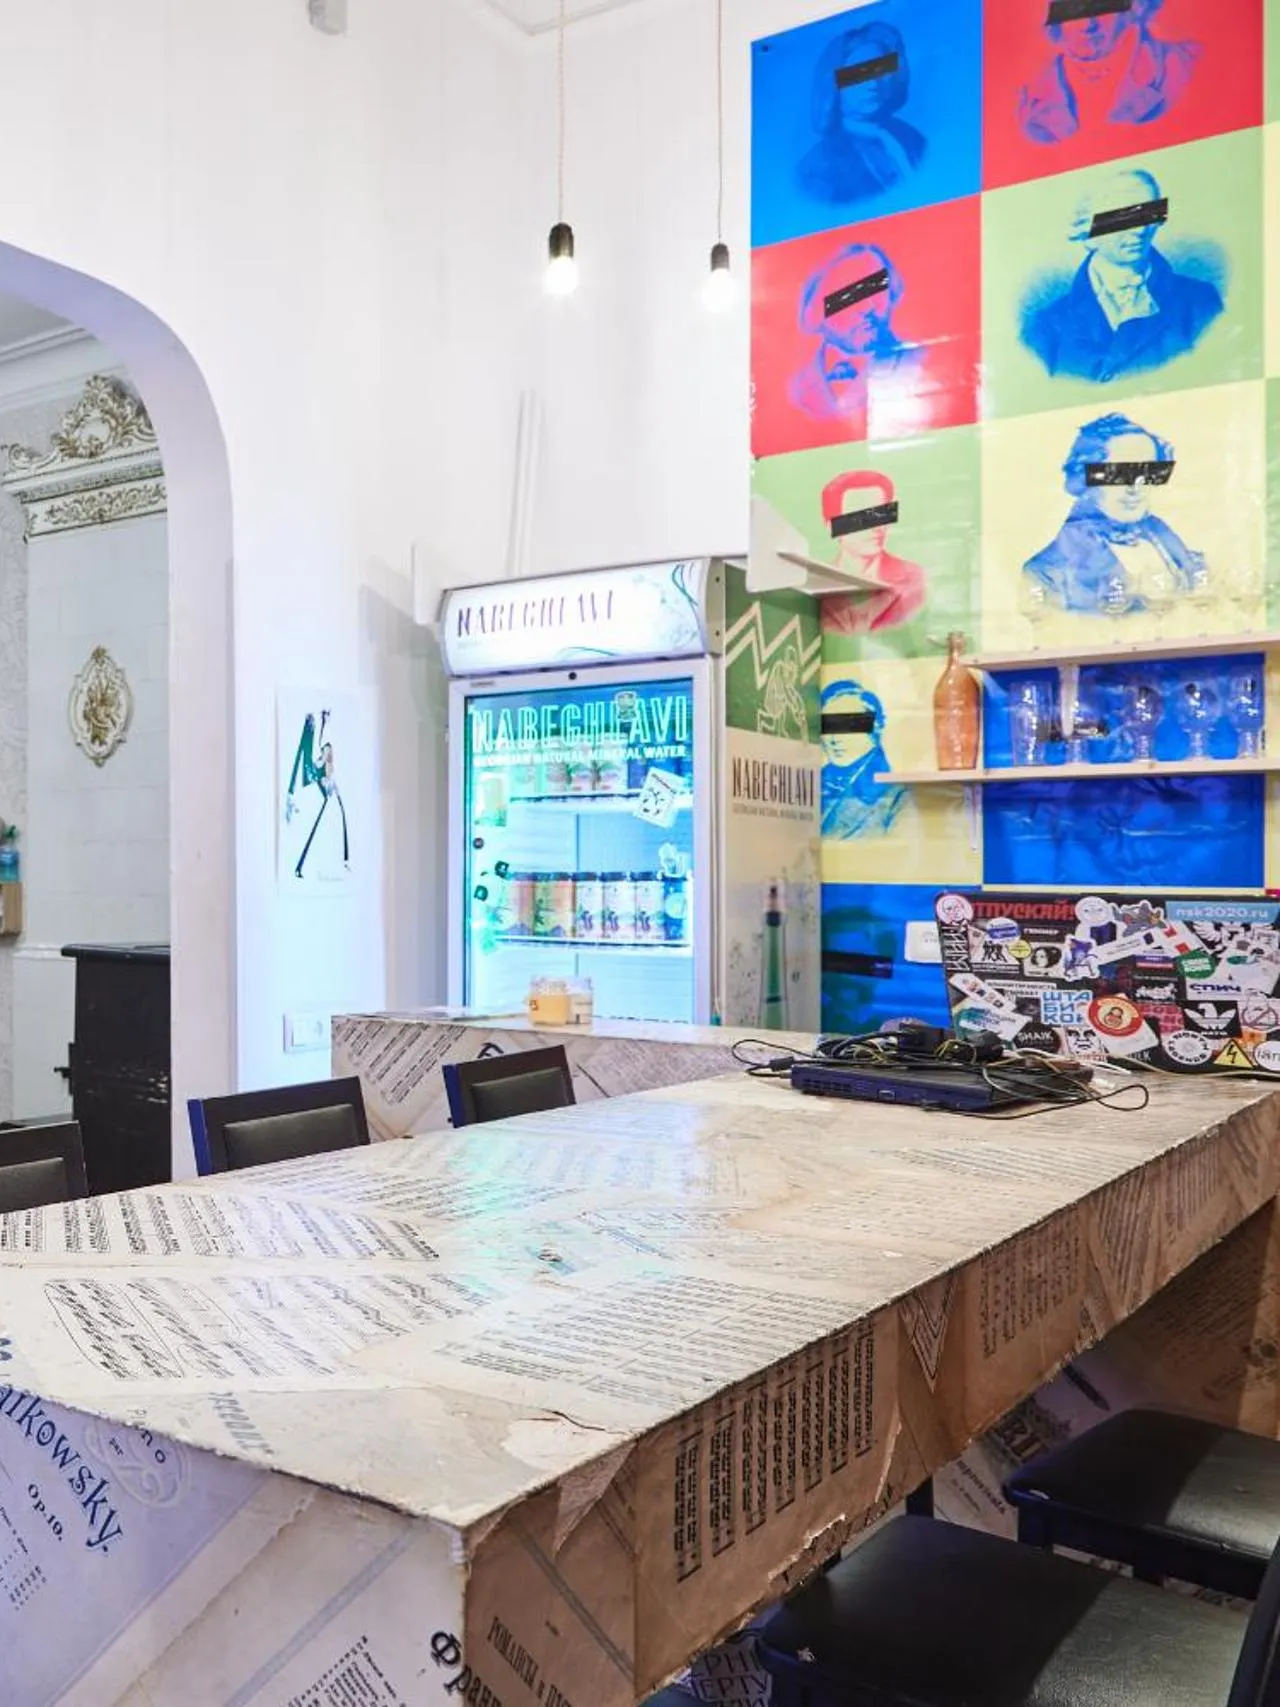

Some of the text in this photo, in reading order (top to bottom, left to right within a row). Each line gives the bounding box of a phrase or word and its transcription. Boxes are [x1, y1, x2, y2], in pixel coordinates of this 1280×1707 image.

[472, 696, 687, 752] NABEGHLAVI
[643, 745, 686, 759] WATER
[732, 757, 813, 806] NABEGHLAVI
[1175, 907, 1269, 918] nsk2020.ru
[1189, 983, 1241, 993] СПИЧ
